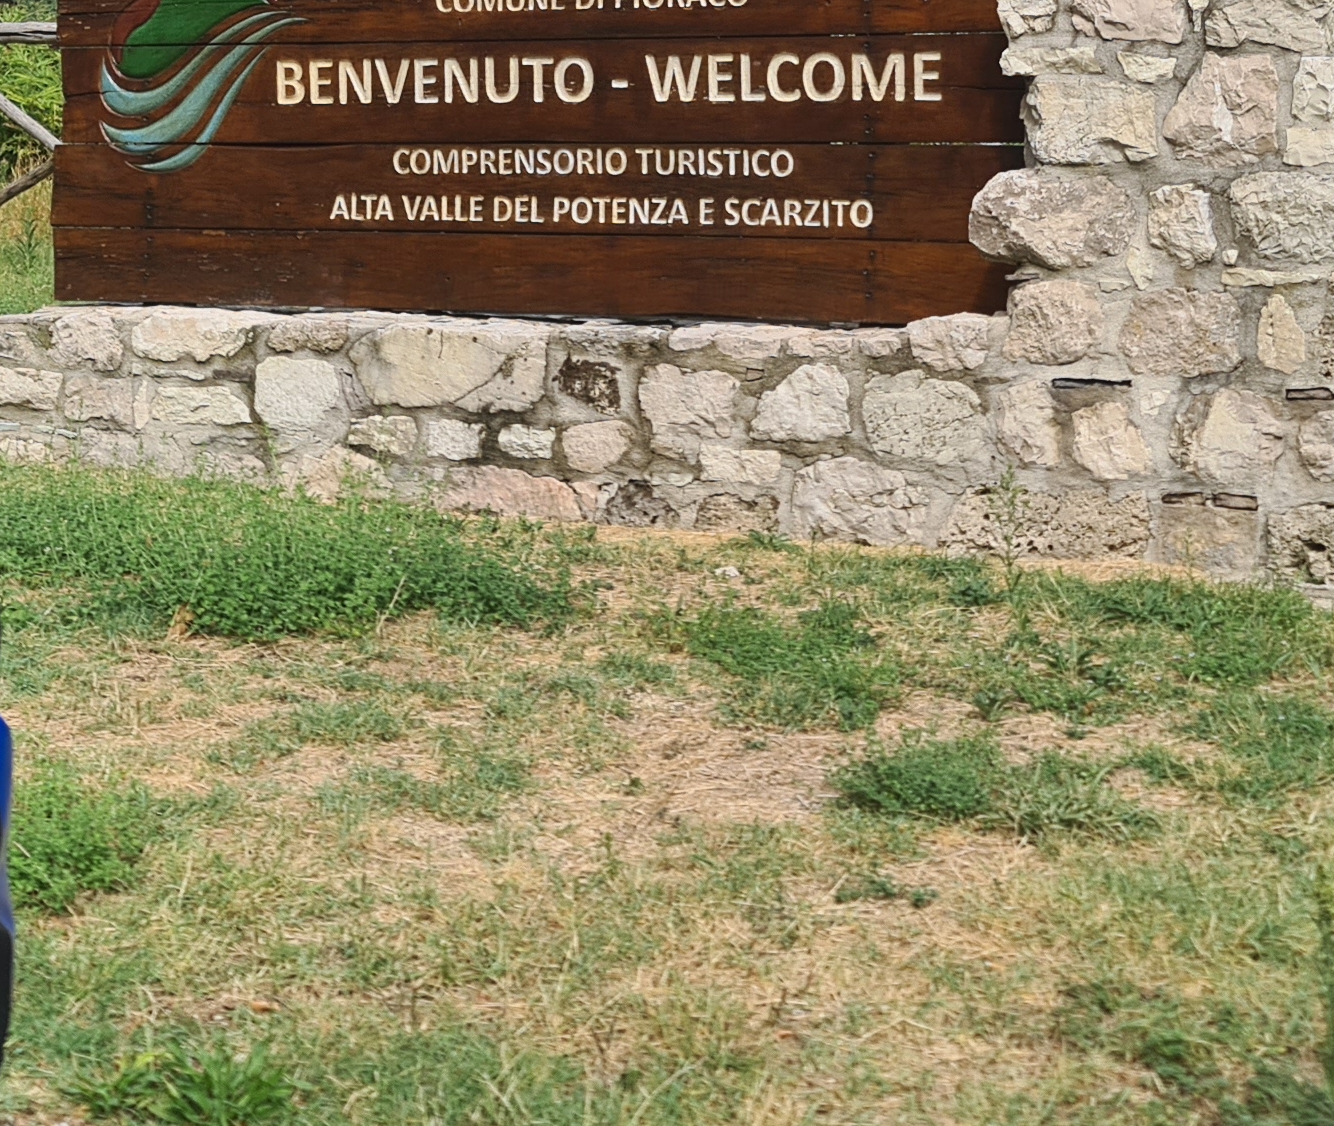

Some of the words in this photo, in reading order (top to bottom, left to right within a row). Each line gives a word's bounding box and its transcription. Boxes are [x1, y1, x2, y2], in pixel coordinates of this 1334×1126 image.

[275, 56, 595, 106] BENVENUTO
[610, 78, 630, 90] -
[643, 51, 944, 105] WELCOME
[391, 147, 629, 176] COMPRENSORIO
[634, 147, 795, 178] TURISTICO
[329, 193, 394, 221] ALTA
[401, 194, 485, 223] VALLE
[492, 195, 546, 224] DEL
[552, 195, 690, 226] POTENZA
[698, 197, 716, 226] E
[723, 197, 875, 230] SCARZITO
